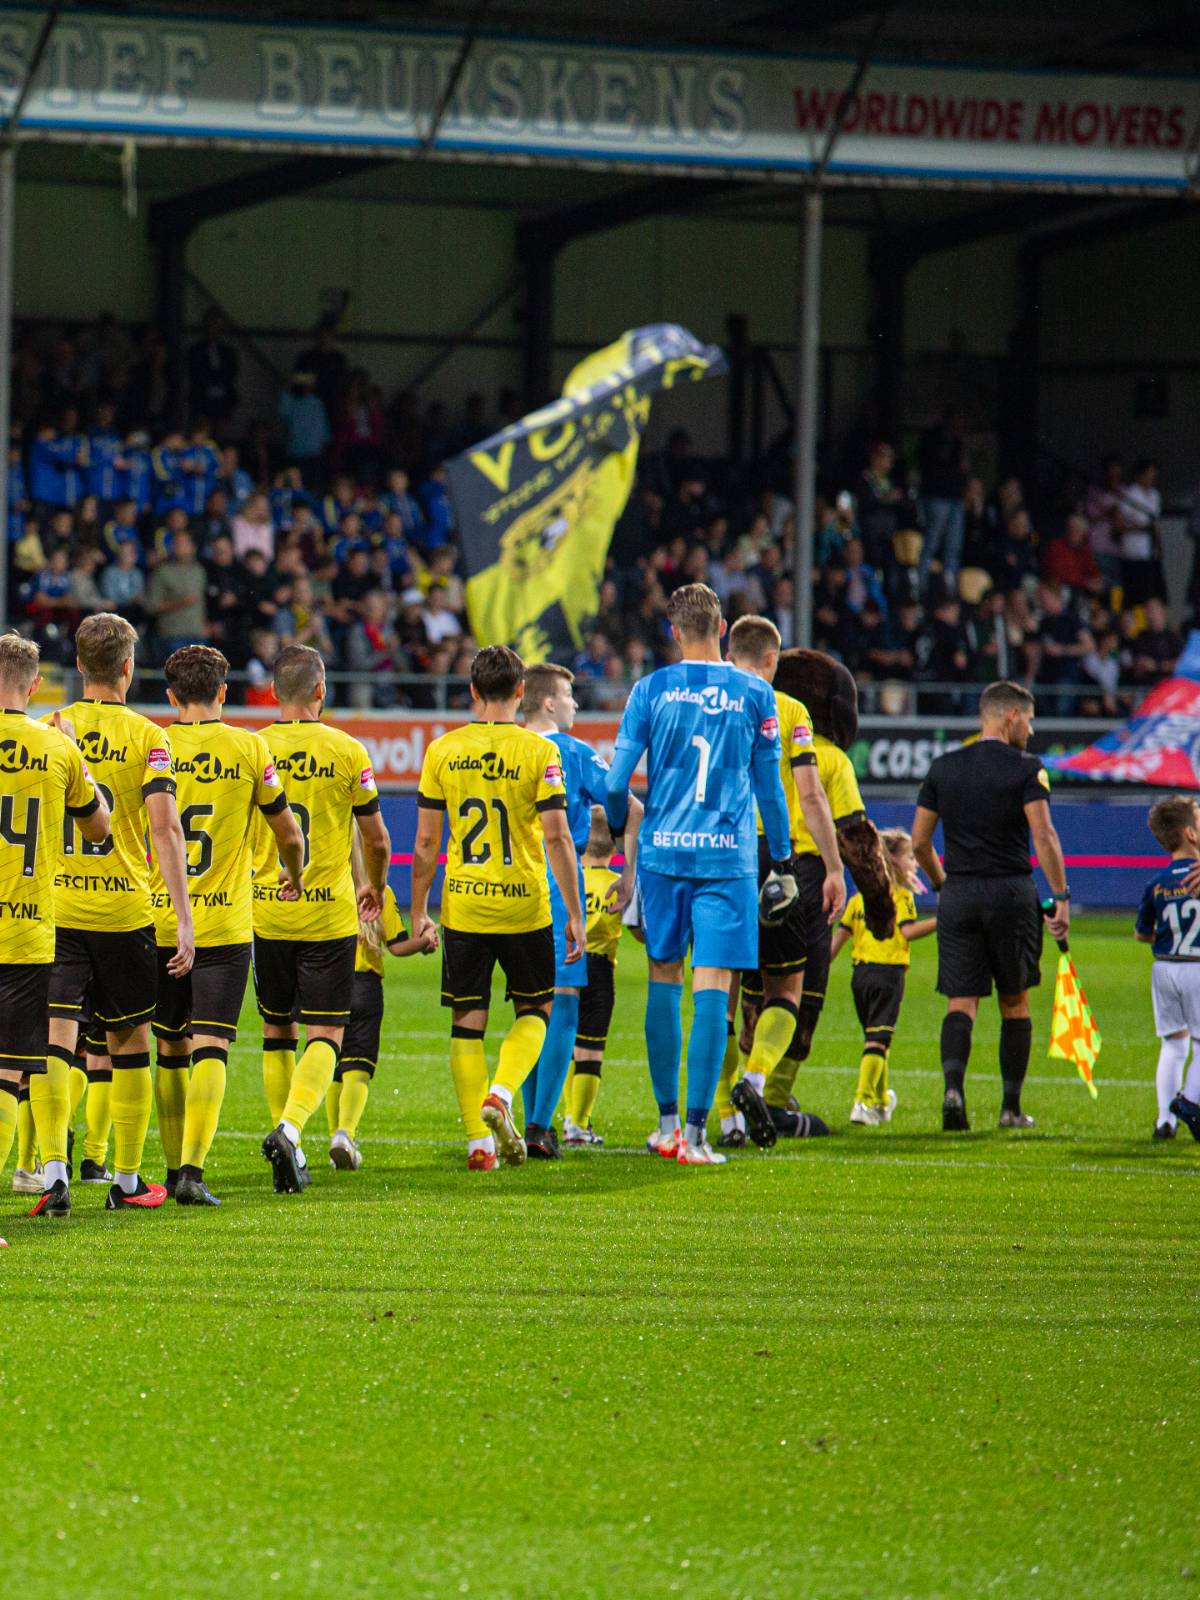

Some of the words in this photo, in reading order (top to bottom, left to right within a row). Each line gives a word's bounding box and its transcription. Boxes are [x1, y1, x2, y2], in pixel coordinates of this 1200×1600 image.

[256, 36, 751, 149] BEURSKENS
[793, 87, 1025, 142] WORLDWIDE
[1034, 102, 1186, 148] MOVERS
[692, 735, 710, 803] 1
[459, 797, 512, 866] 21
[653, 832, 738, 848] BETCITY.NL
[54, 874, 135, 892] ETCITY.NL
[151, 891, 233, 908] BETTY.NL
[253, 885, 336, 902] BETCY.NL
[449, 878, 531, 898] BETCITY.NL
[1162, 898, 1200, 957] 12
